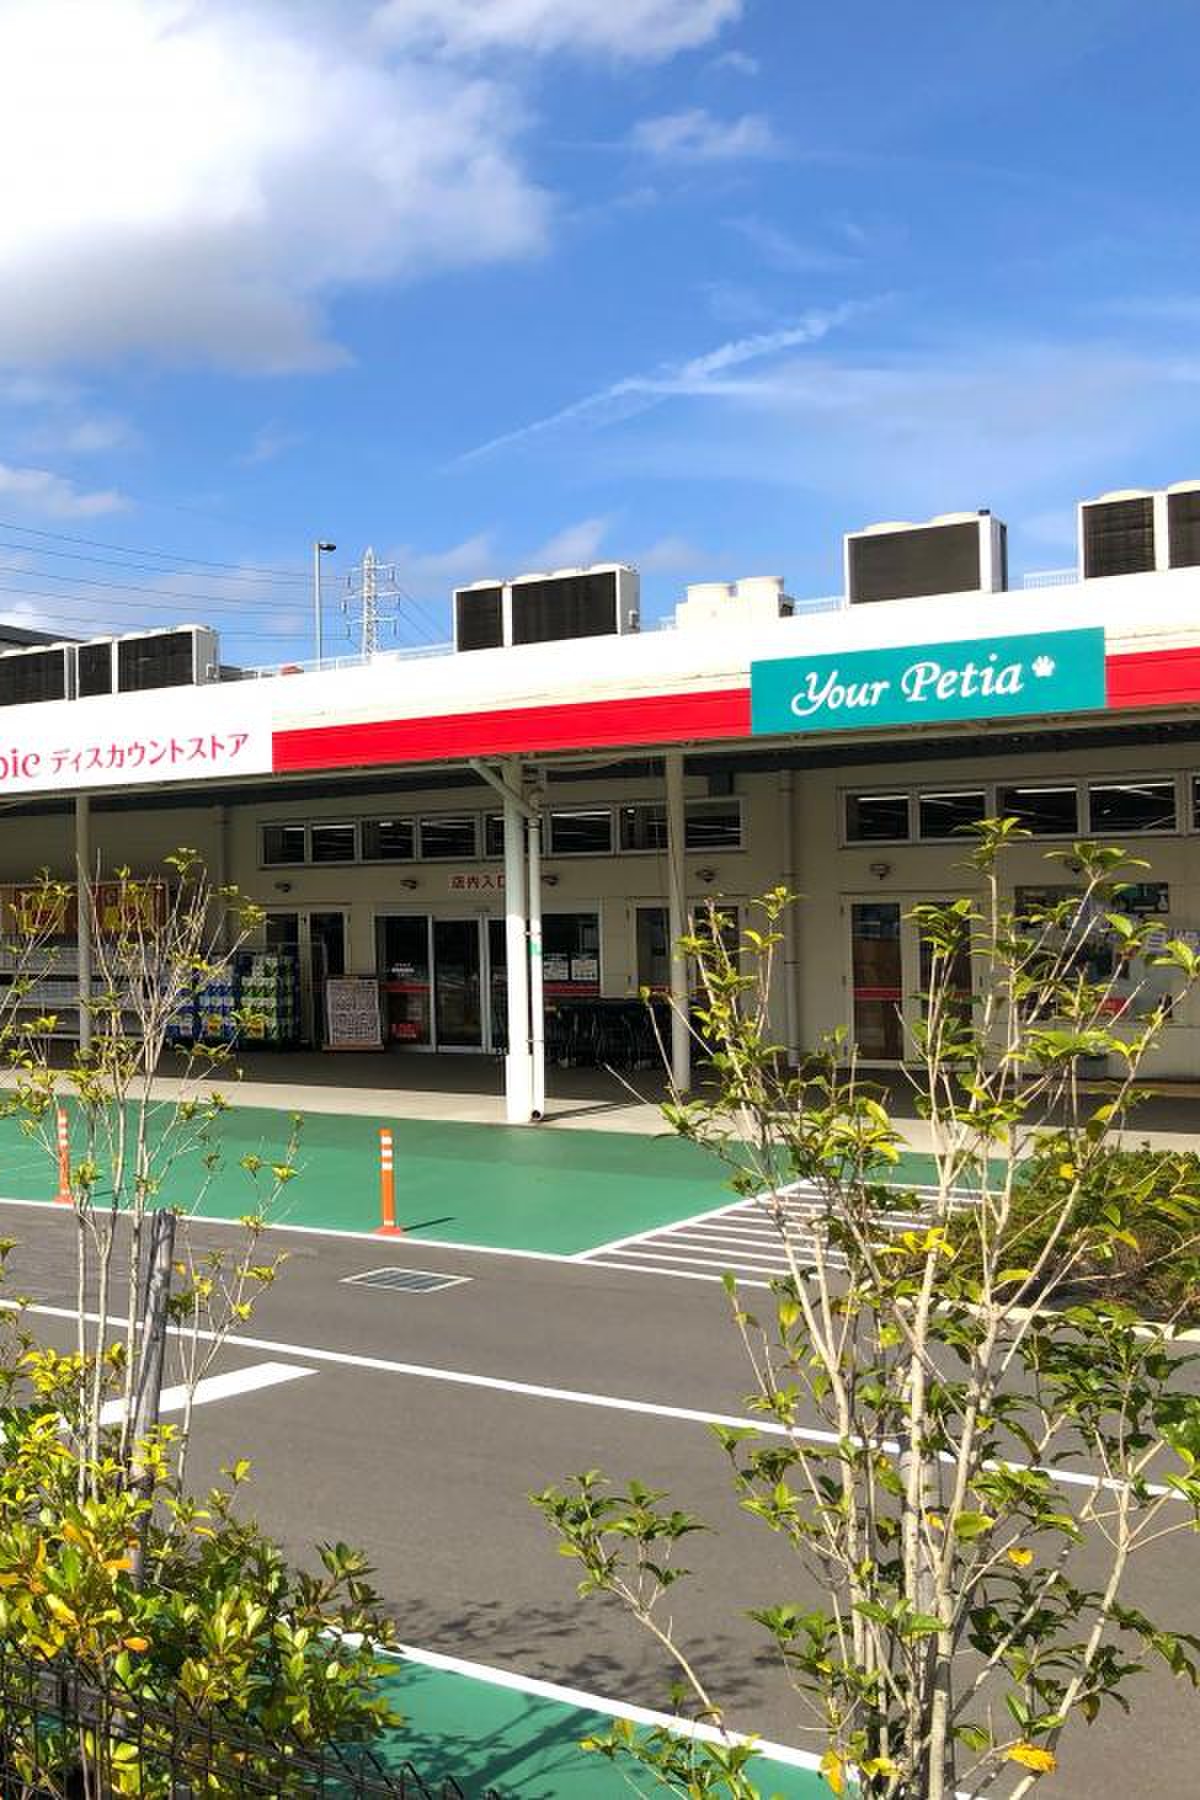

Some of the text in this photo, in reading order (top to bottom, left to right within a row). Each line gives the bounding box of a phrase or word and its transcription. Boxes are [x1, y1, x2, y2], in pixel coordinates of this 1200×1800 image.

[790, 652, 1025, 717] Your Petia
[50, 733, 250, 774] ディスカウントストア
